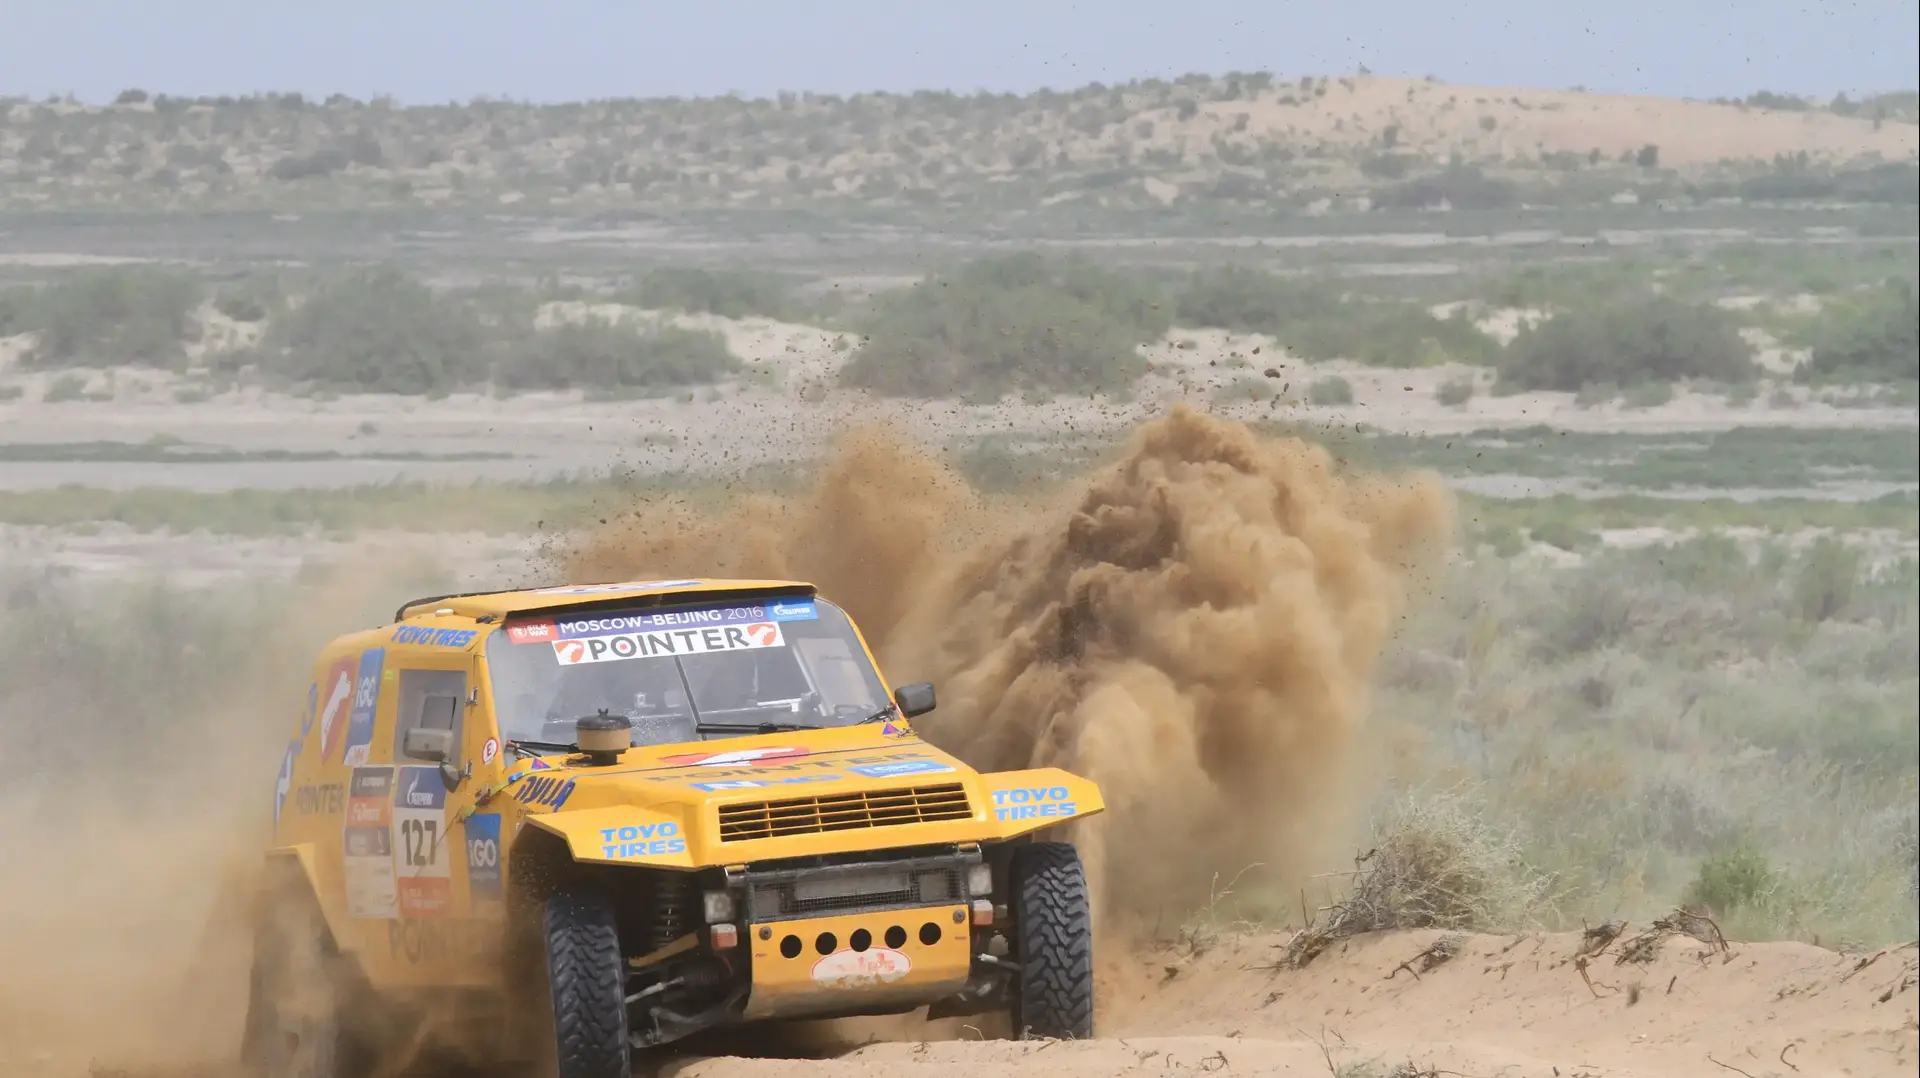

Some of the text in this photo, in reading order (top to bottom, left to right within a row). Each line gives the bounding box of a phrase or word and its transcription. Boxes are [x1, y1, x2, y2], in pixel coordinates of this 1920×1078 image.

[725, 606, 764, 620] 2016
[391, 625, 478, 648] TOYO TIRES
[530, 629, 549, 637] WAY
[588, 627, 749, 660] POINTER
[992, 786, 1069, 805] TOYO
[994, 802, 1077, 821] TIRES
[600, 822, 678, 842] TOYO
[402, 819, 437, 866] 127
[602, 839, 686, 859] TIRES
